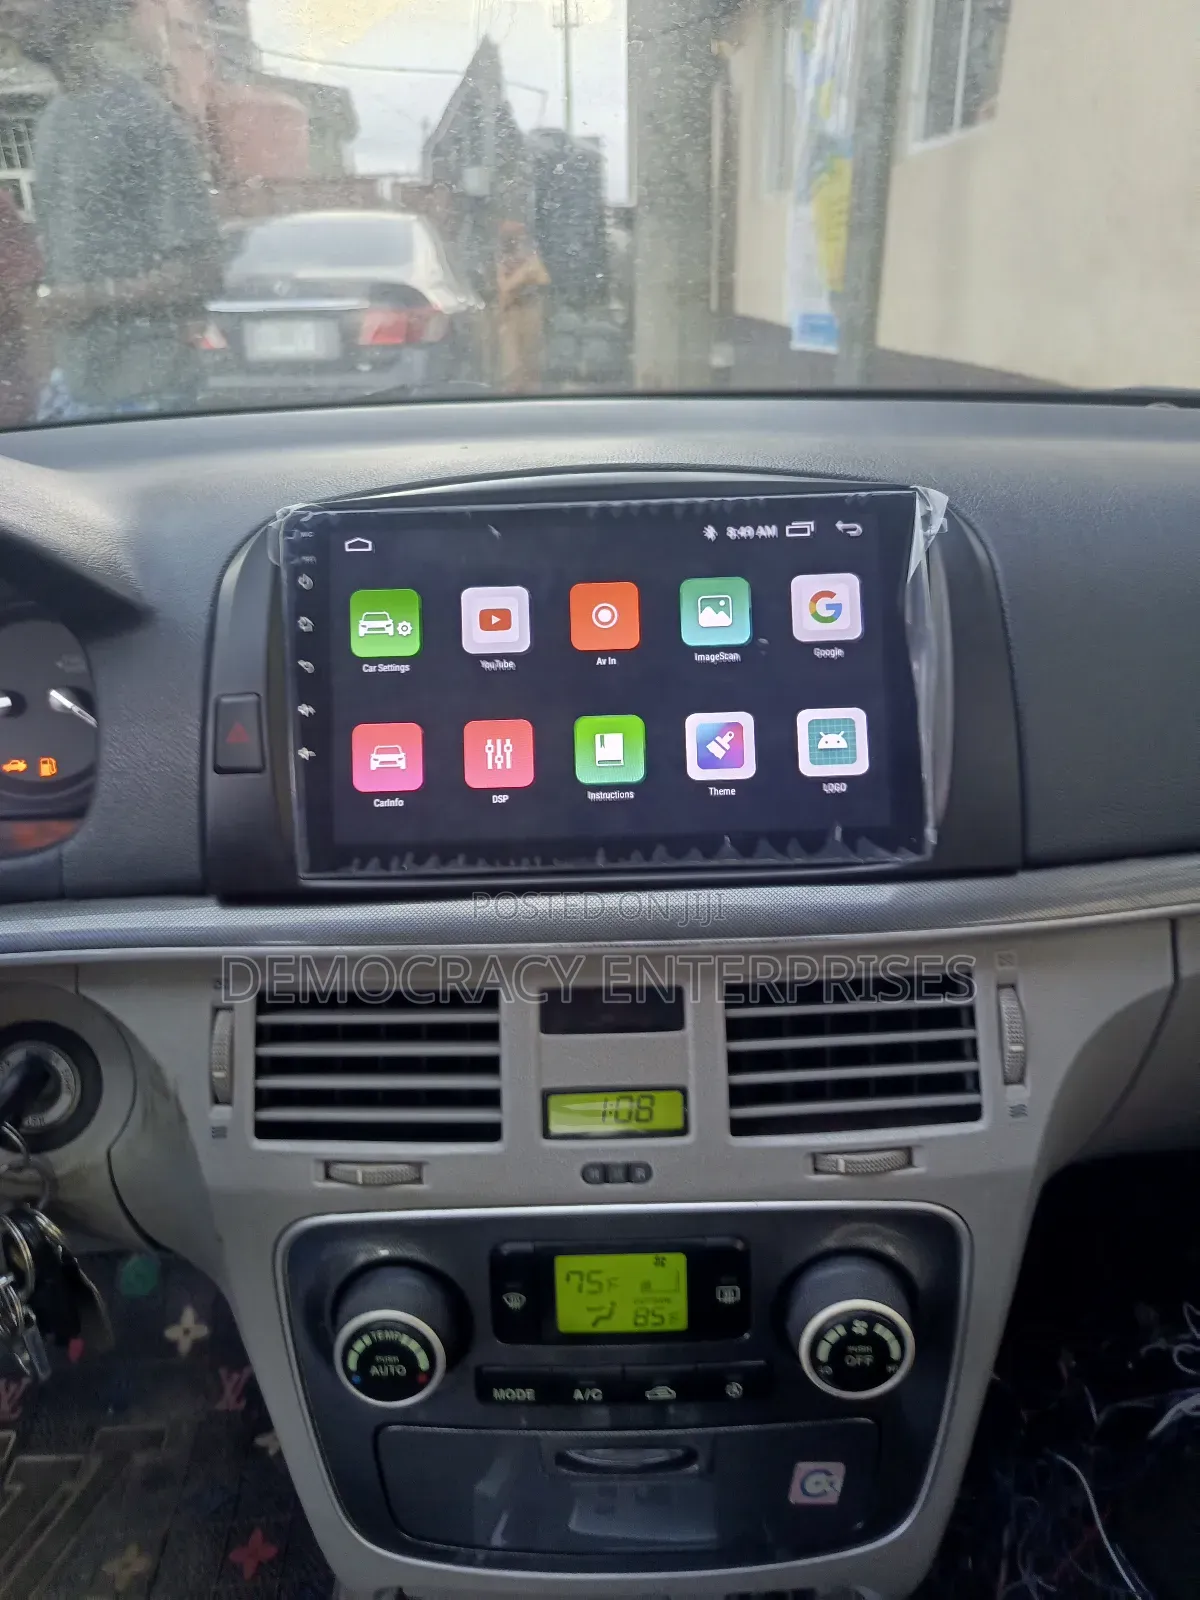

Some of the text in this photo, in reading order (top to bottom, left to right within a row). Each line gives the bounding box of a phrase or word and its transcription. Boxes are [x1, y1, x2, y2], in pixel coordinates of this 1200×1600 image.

[756, 525, 779, 538] AM
[694, 652, 741, 664] ImageScan
[813, 647, 845, 659] Google
[480, 660, 516, 671] YouTube
[596, 657, 617, 666] Av In
[362, 663, 410, 675] Car Settings
[587, 790, 634, 801] Instructions
[709, 787, 736, 796] Theme
[492, 795, 509, 804] DSP
[601, 1094, 655, 1123] 1:08
[370, 1364, 407, 1376] AUTO
[492, 1388, 536, 1401] MODE
[573, 1388, 603, 1401] A/C
